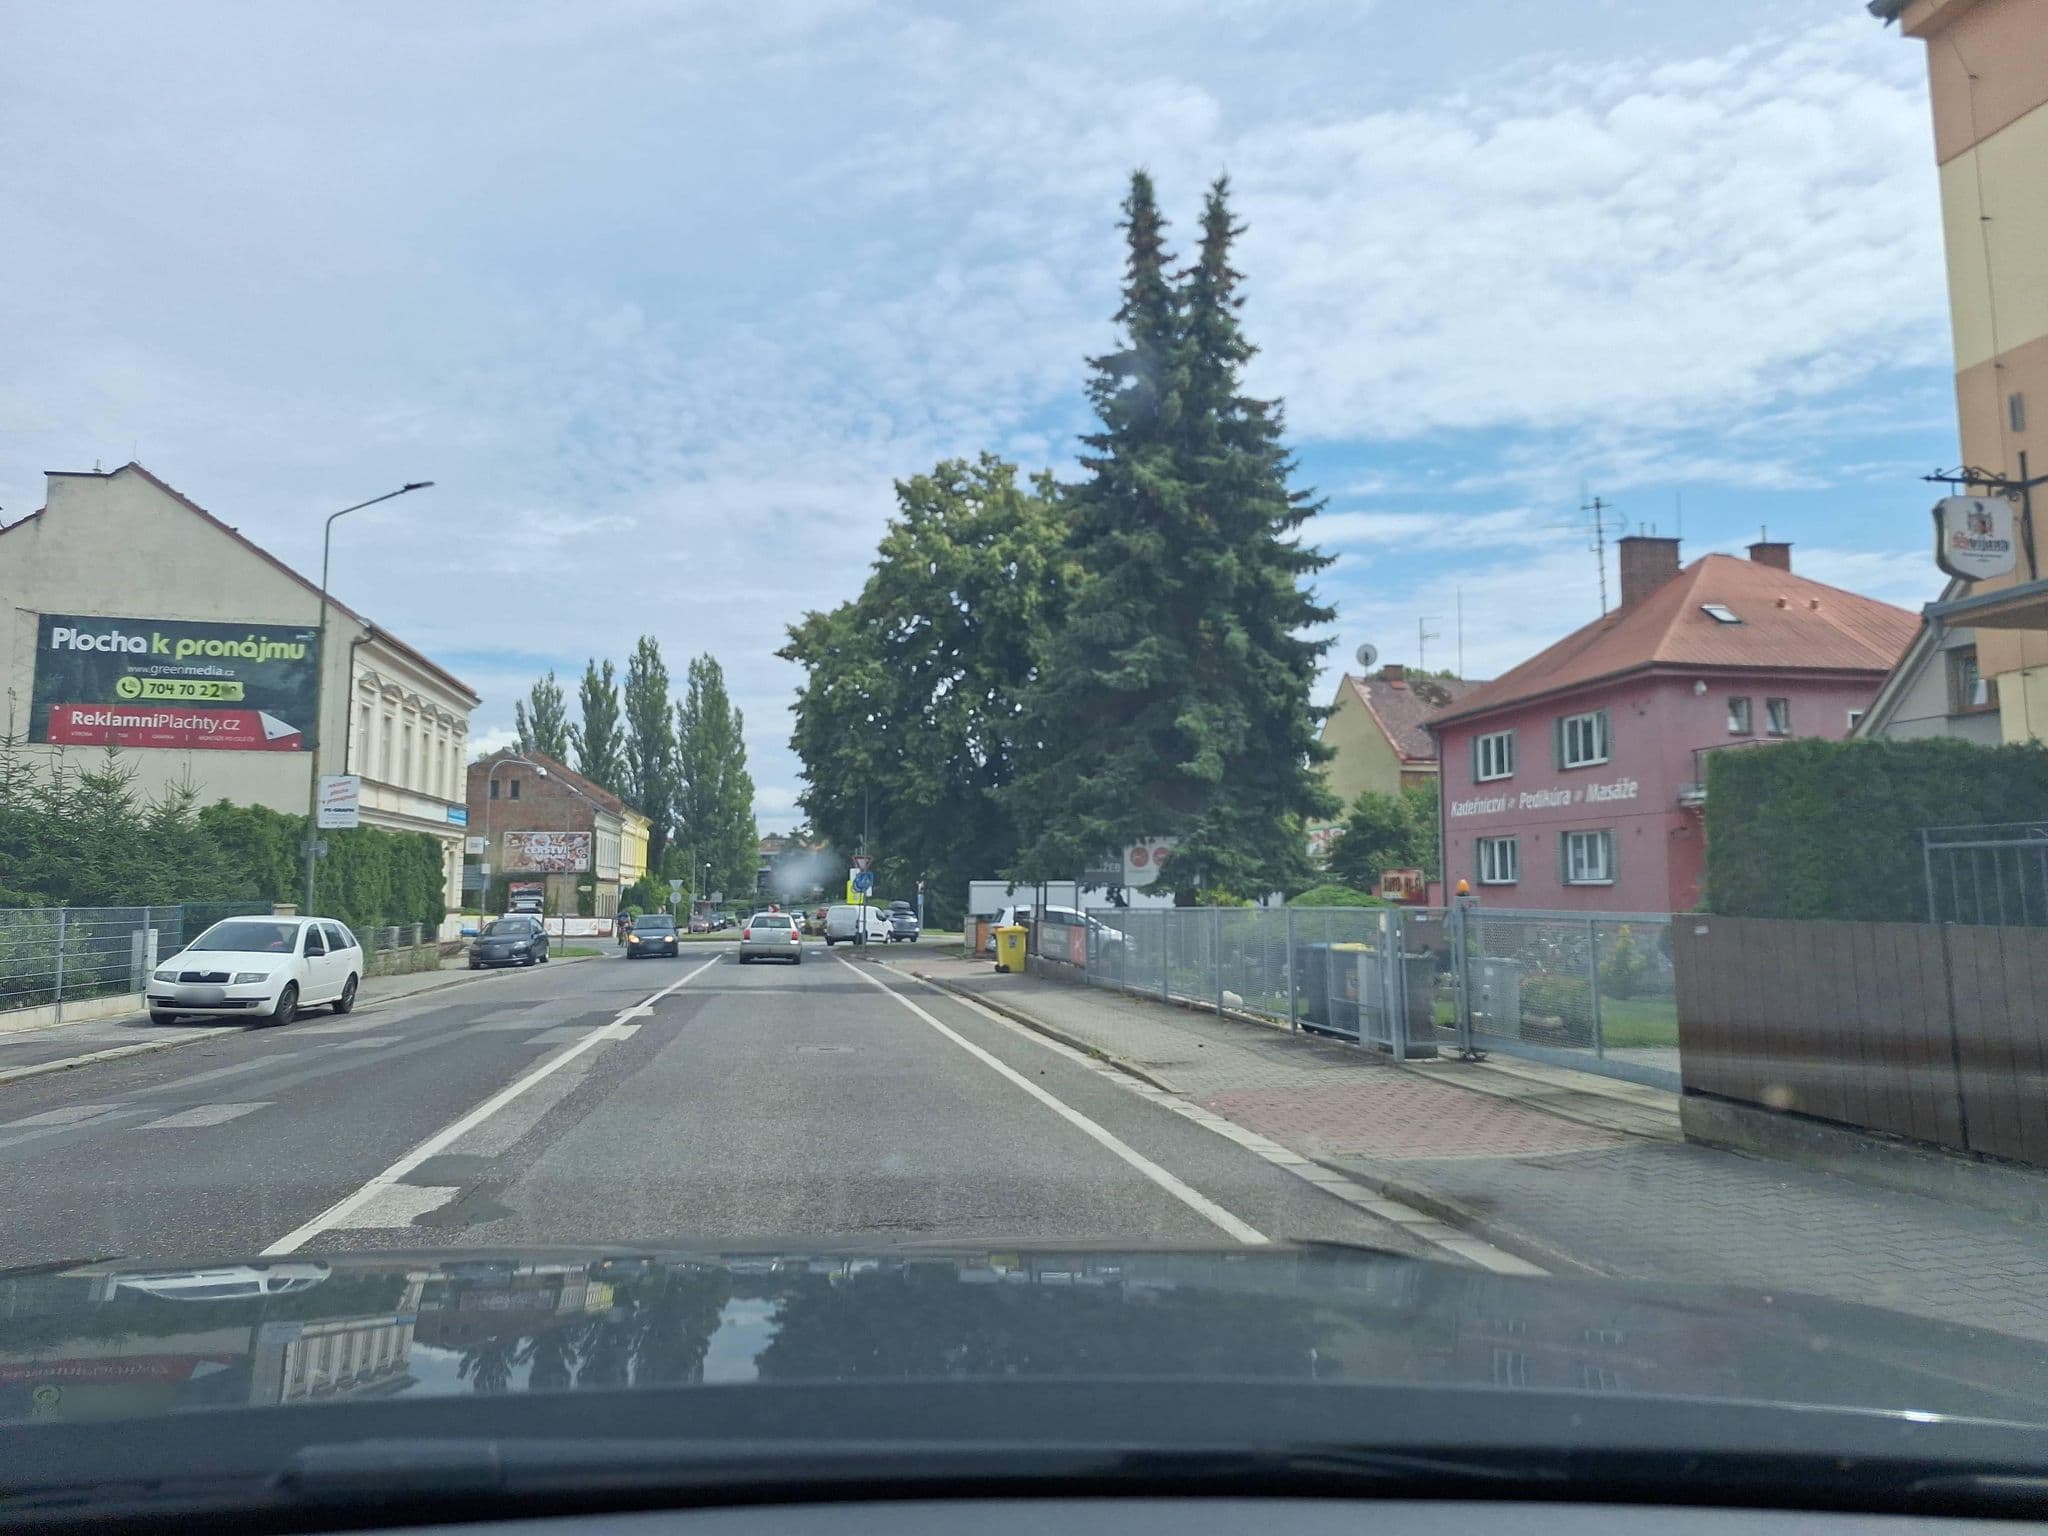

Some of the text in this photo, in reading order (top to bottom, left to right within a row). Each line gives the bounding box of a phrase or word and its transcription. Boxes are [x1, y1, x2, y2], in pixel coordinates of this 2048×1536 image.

[52, 627, 306, 663] Plocha k pronájmu
[127, 664, 235, 677] www.greenmedia.cz
[149, 683, 175, 695] 704
[179, 684, 196, 696] 70
[71, 711, 241, 733] ReklamniPlachty.cz
[1585, 776, 1639, 802] Masáže
